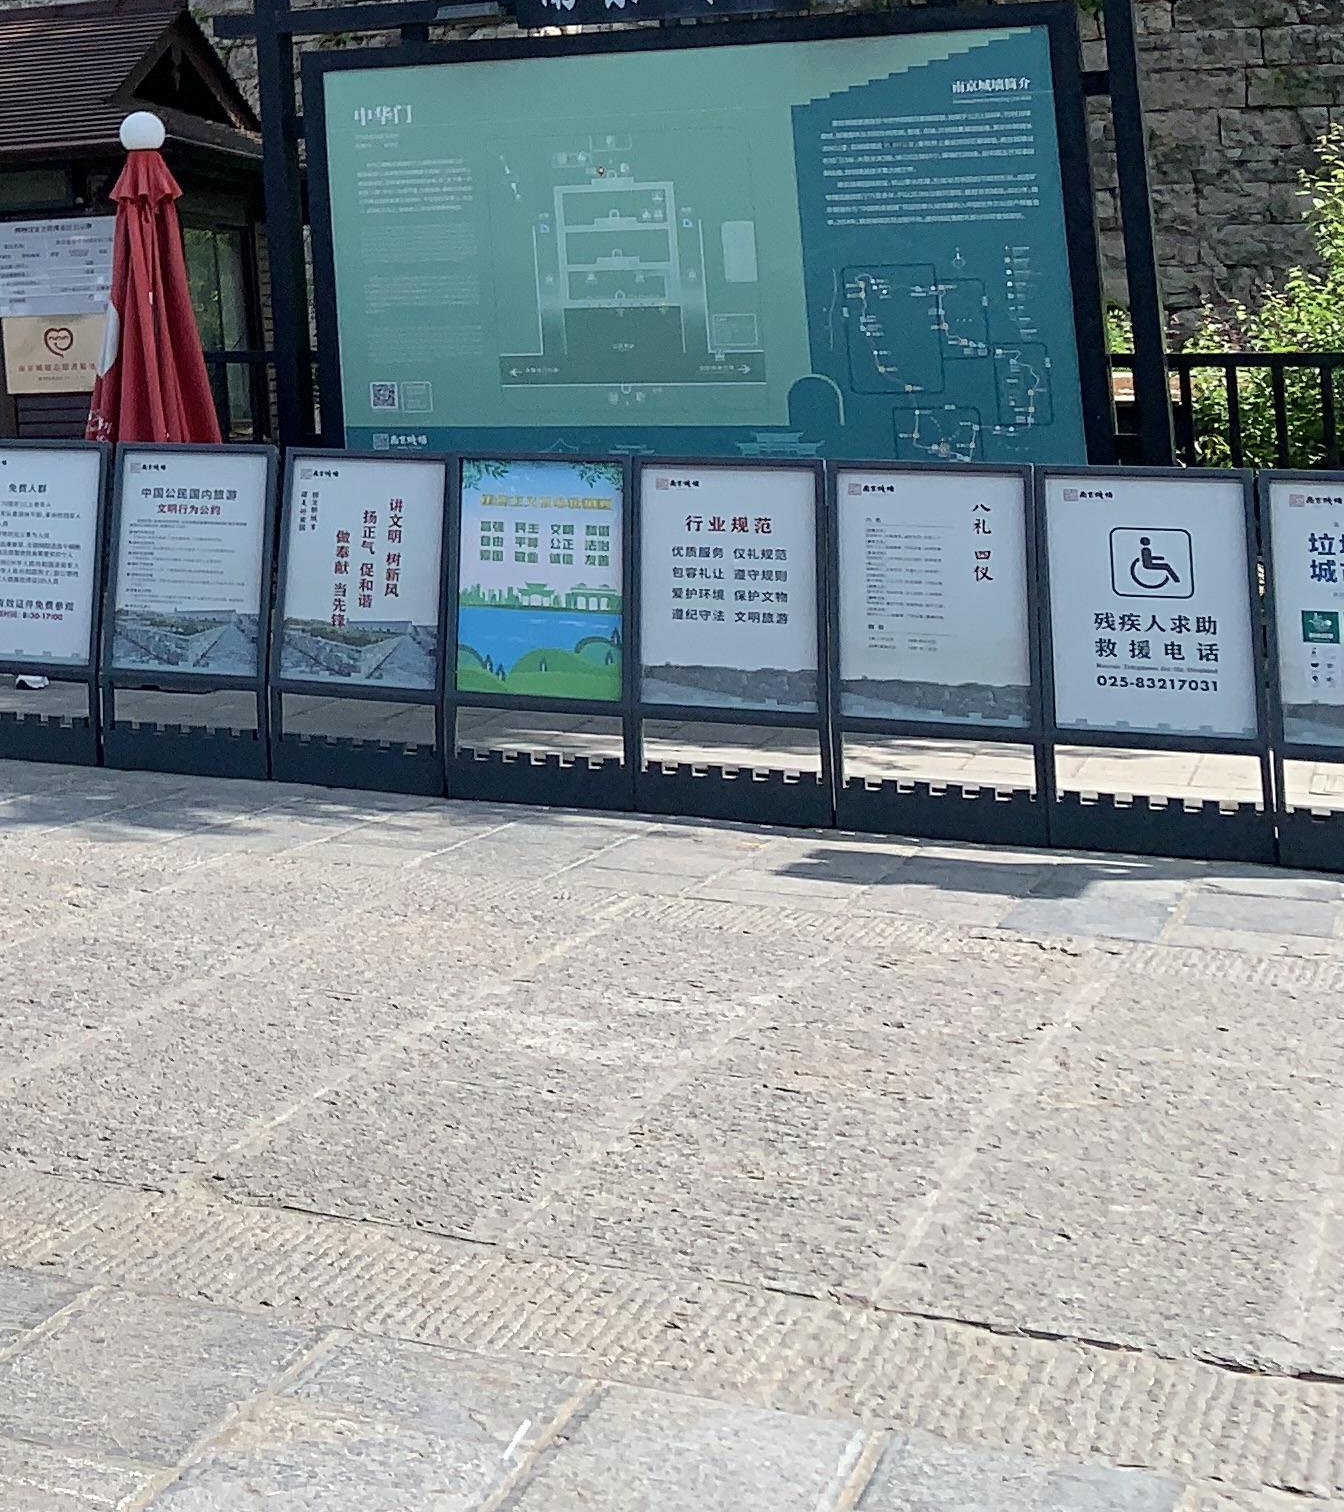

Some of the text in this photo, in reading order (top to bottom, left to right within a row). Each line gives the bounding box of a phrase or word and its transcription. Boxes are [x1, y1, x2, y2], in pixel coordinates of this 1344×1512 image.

[354, 105, 412, 126] 中华门
[8, 483, 47, 494] 免费人群
[141, 488, 238, 500] 中国公民国内旅游
[157, 503, 221, 515] 文明行为公约
[971, 503, 992, 535] 八礼
[685, 514, 773, 534] 行业规范
[333, 530, 351, 575] 做奉献
[384, 498, 404, 598] 讲文明 树新风
[672, 546, 724, 558] 优质服务
[1308, 532, 1344, 555] 垃
[358, 510, 378, 609] 扬正气 促和谐
[672, 566, 788, 582] 包容礼让 遵守规则
[1310, 559, 1344, 583] 城
[672, 587, 788, 604] 爱护环境 保护文物
[672, 608, 788, 625] 遵纪守法 文明旅游
[1094, 612, 1217, 635] 残疾人求助
[1095, 638, 1219, 662] 救援电话
[1096, 675, 1218, 692] 025-83217031
